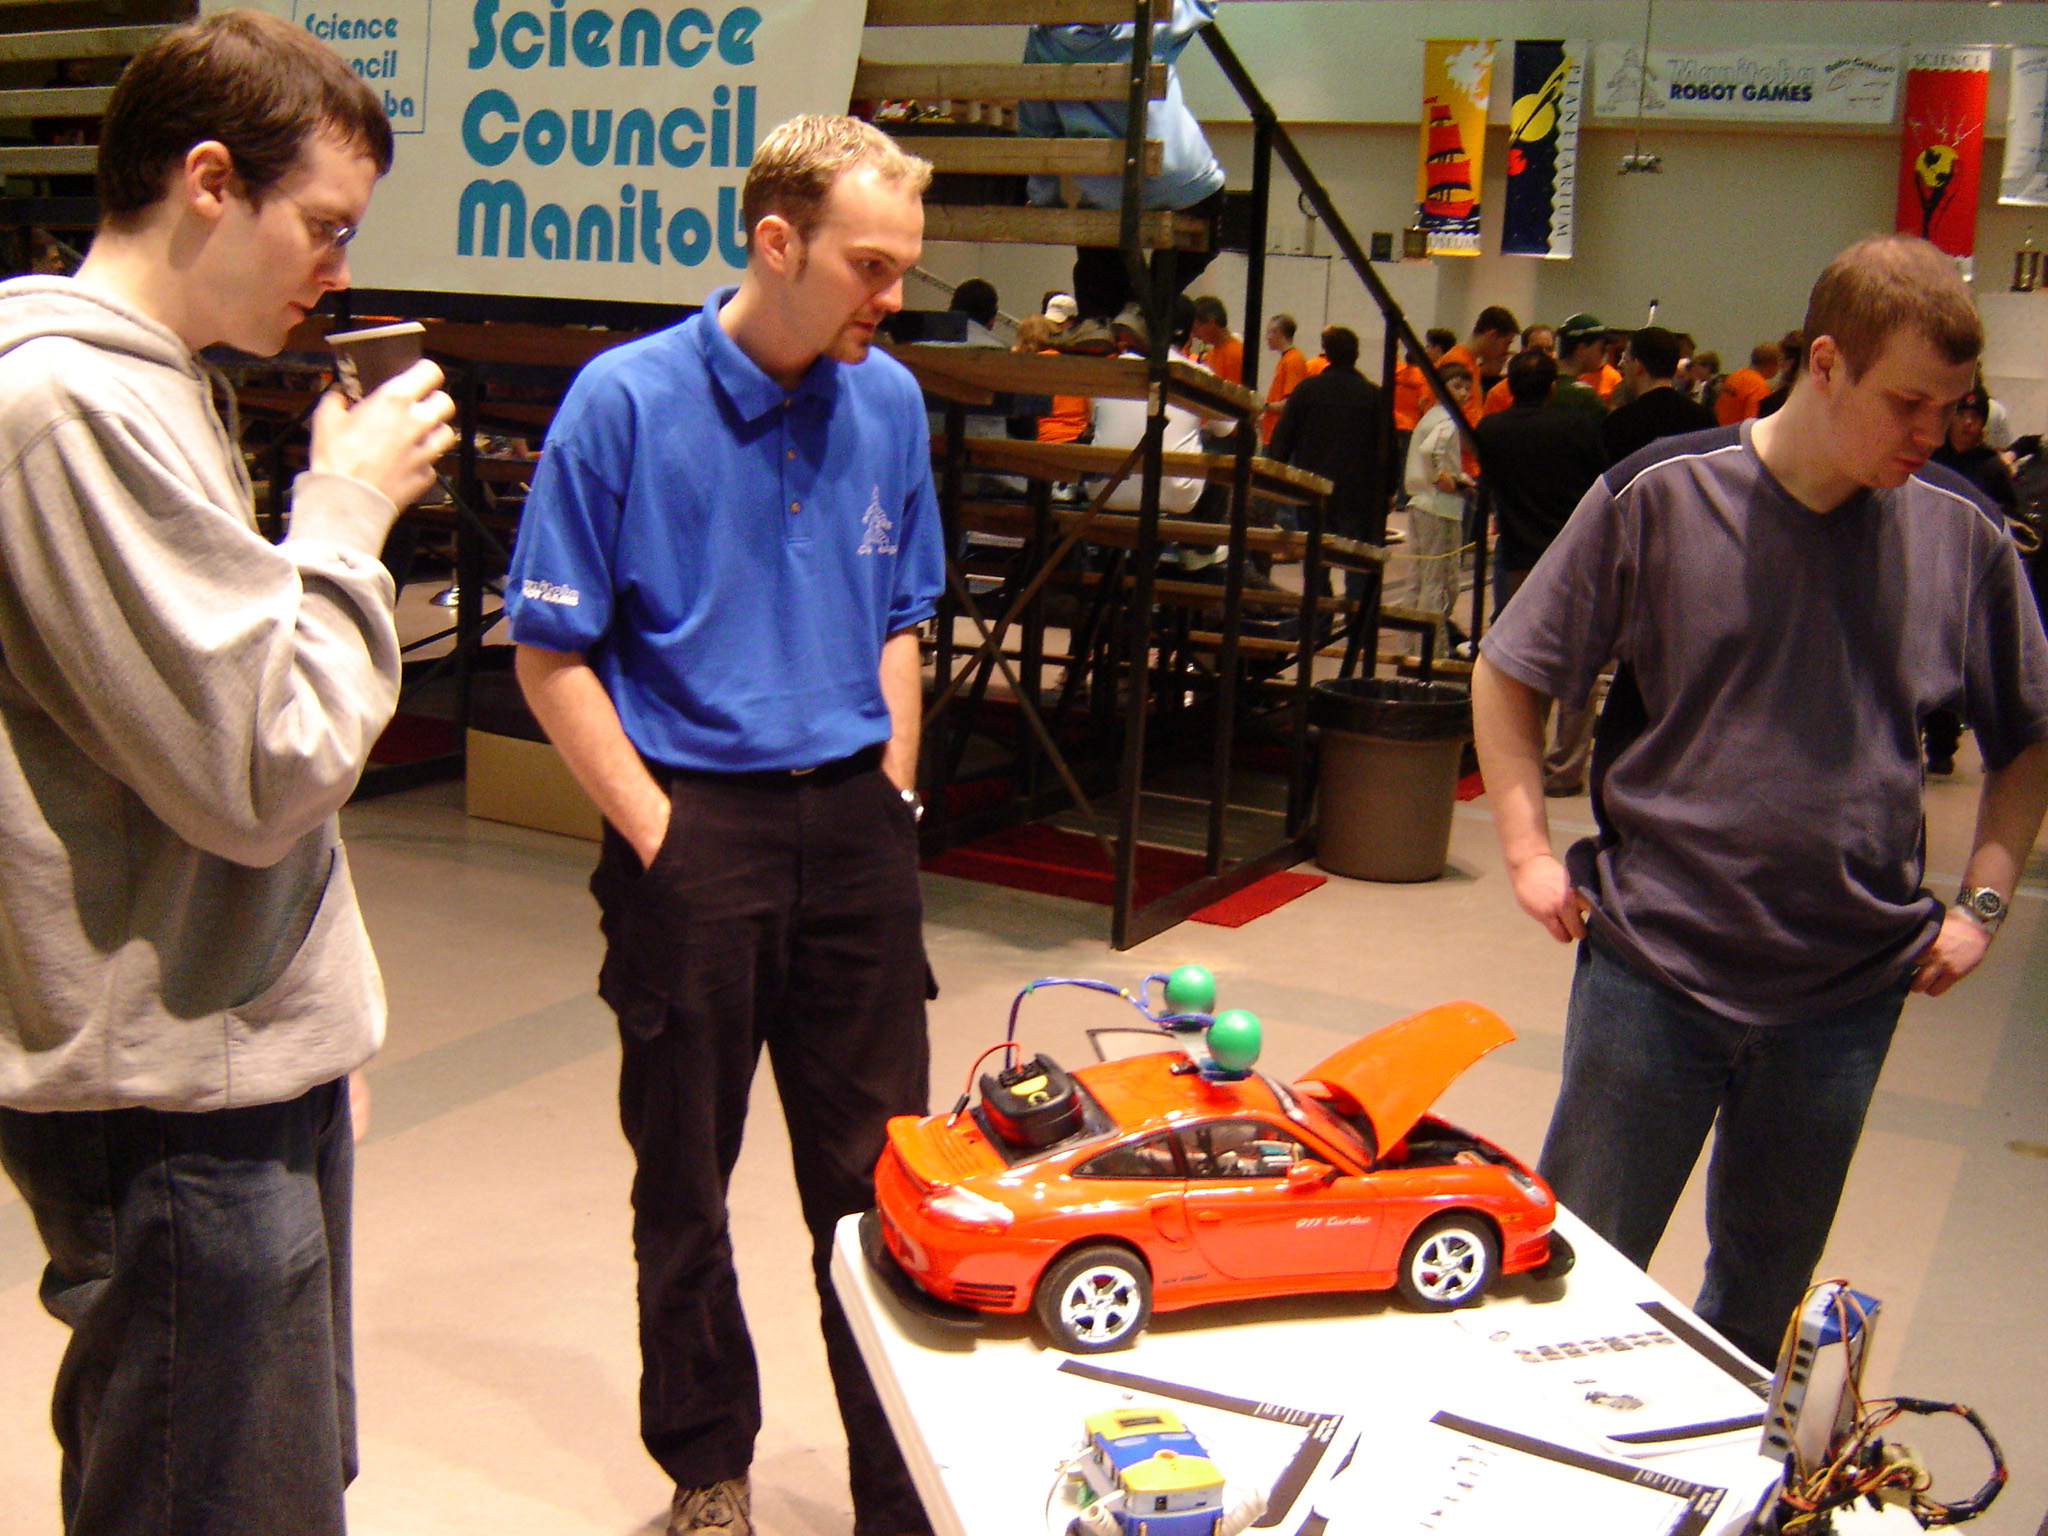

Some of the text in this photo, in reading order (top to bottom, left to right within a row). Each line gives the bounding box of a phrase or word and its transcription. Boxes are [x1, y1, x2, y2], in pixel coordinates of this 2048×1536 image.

[468, 0, 762, 70] Science
[462, 85, 757, 167] Council
[1669, 84, 1813, 103] ROBOT GAMES
[1556, 65, 1581, 236] PLANETARIUM
[1296, 1217, 1323, 1229] 911
